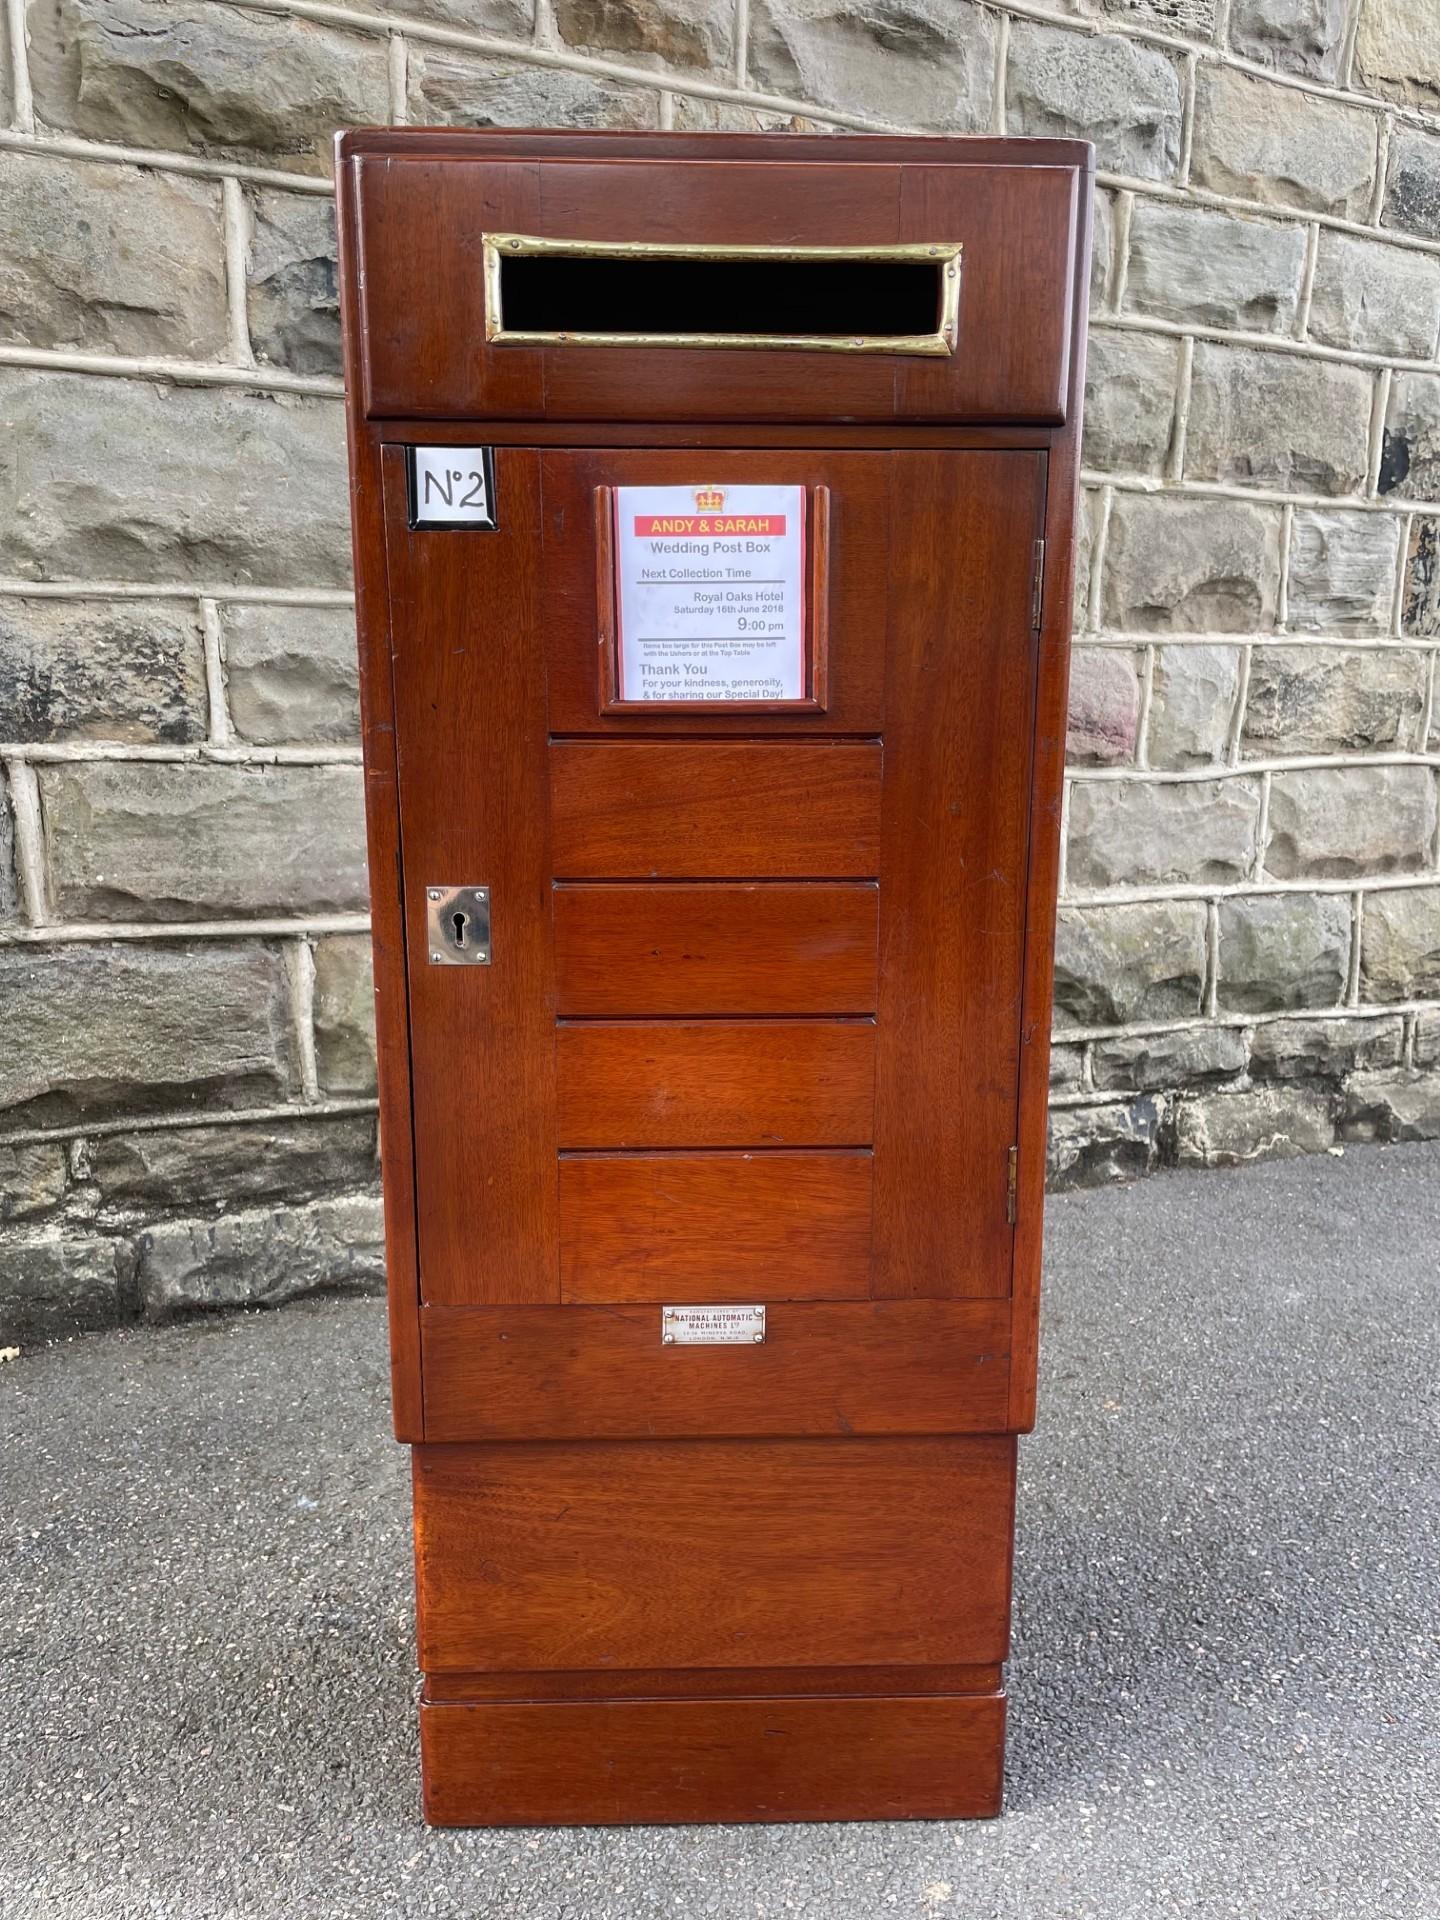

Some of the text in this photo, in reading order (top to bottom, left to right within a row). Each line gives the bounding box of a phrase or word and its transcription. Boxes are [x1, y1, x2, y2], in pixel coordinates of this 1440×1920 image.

[651, 519, 769, 532] ANDY & SARAH
[651, 542, 770, 555] Wedding Post Box
[642, 568, 751, 578] Next Collection Time
[694, 592, 783, 604] Royal Oaks Hotel
[674, 606, 713, 615] Saturday
[738, 618, 784, 632] 9:00 pm
[639, 664, 708, 675] Thank You
[661, 680, 682, 689] your
[684, 679, 729, 688] kindness,
[731, 678, 783, 688] generosity,
[668, 691, 704, 699] sharing
[724, 690, 760, 699] Special
[763, 690, 783, 699] Day!
